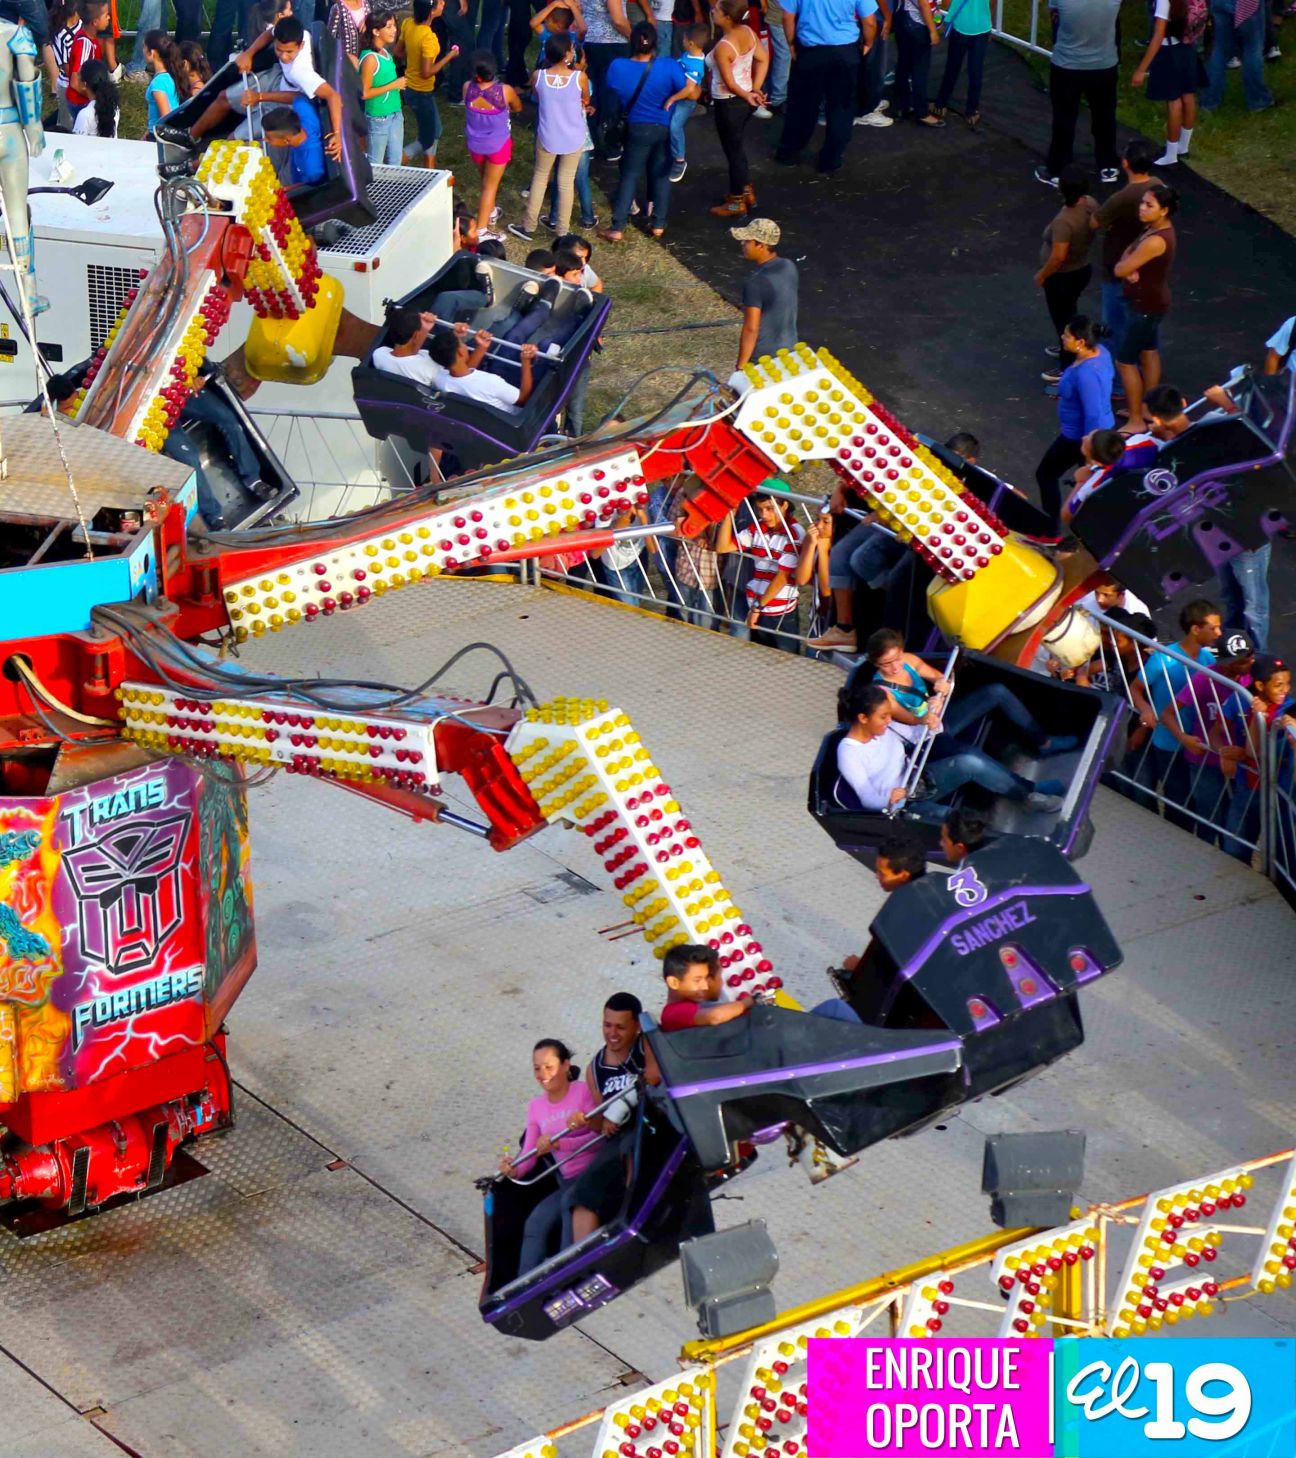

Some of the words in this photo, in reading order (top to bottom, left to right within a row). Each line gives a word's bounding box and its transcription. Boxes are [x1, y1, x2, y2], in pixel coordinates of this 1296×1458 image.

[1144, 468, 1178, 495] 6
[60, 776, 166, 849] TRANS
[947, 866, 988, 907] 3
[950, 900, 1038, 956] SANCHEZ
[71, 965, 205, 1055] FORMERS
